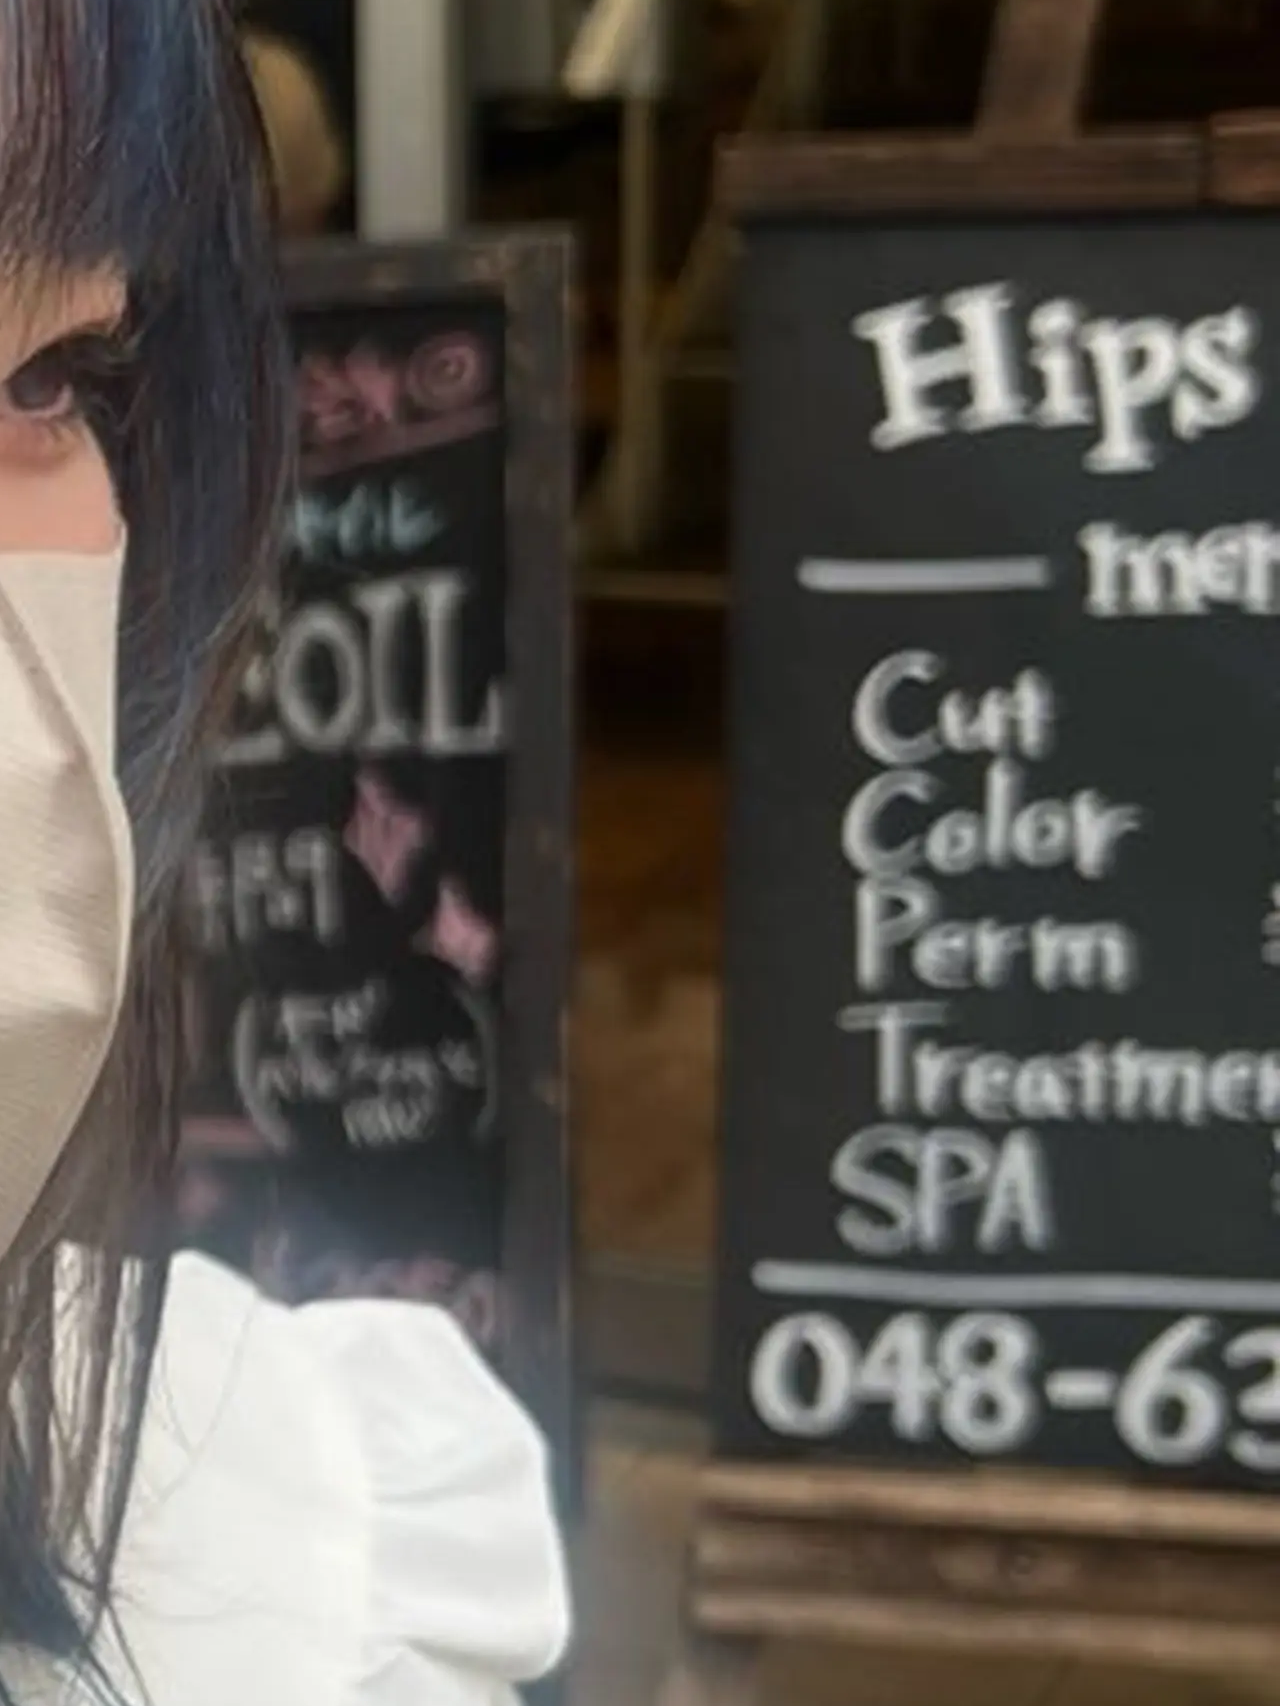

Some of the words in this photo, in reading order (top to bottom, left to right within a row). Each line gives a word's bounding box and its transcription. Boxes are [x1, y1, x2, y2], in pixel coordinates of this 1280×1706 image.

[852, 281, 1260, 473] Hips
[851, 649, 1053, 766] Cut
[842, 768, 1142, 880] Color
[855, 875, 1134, 991] Perm
[832, 1123, 1052, 1255] SPA
